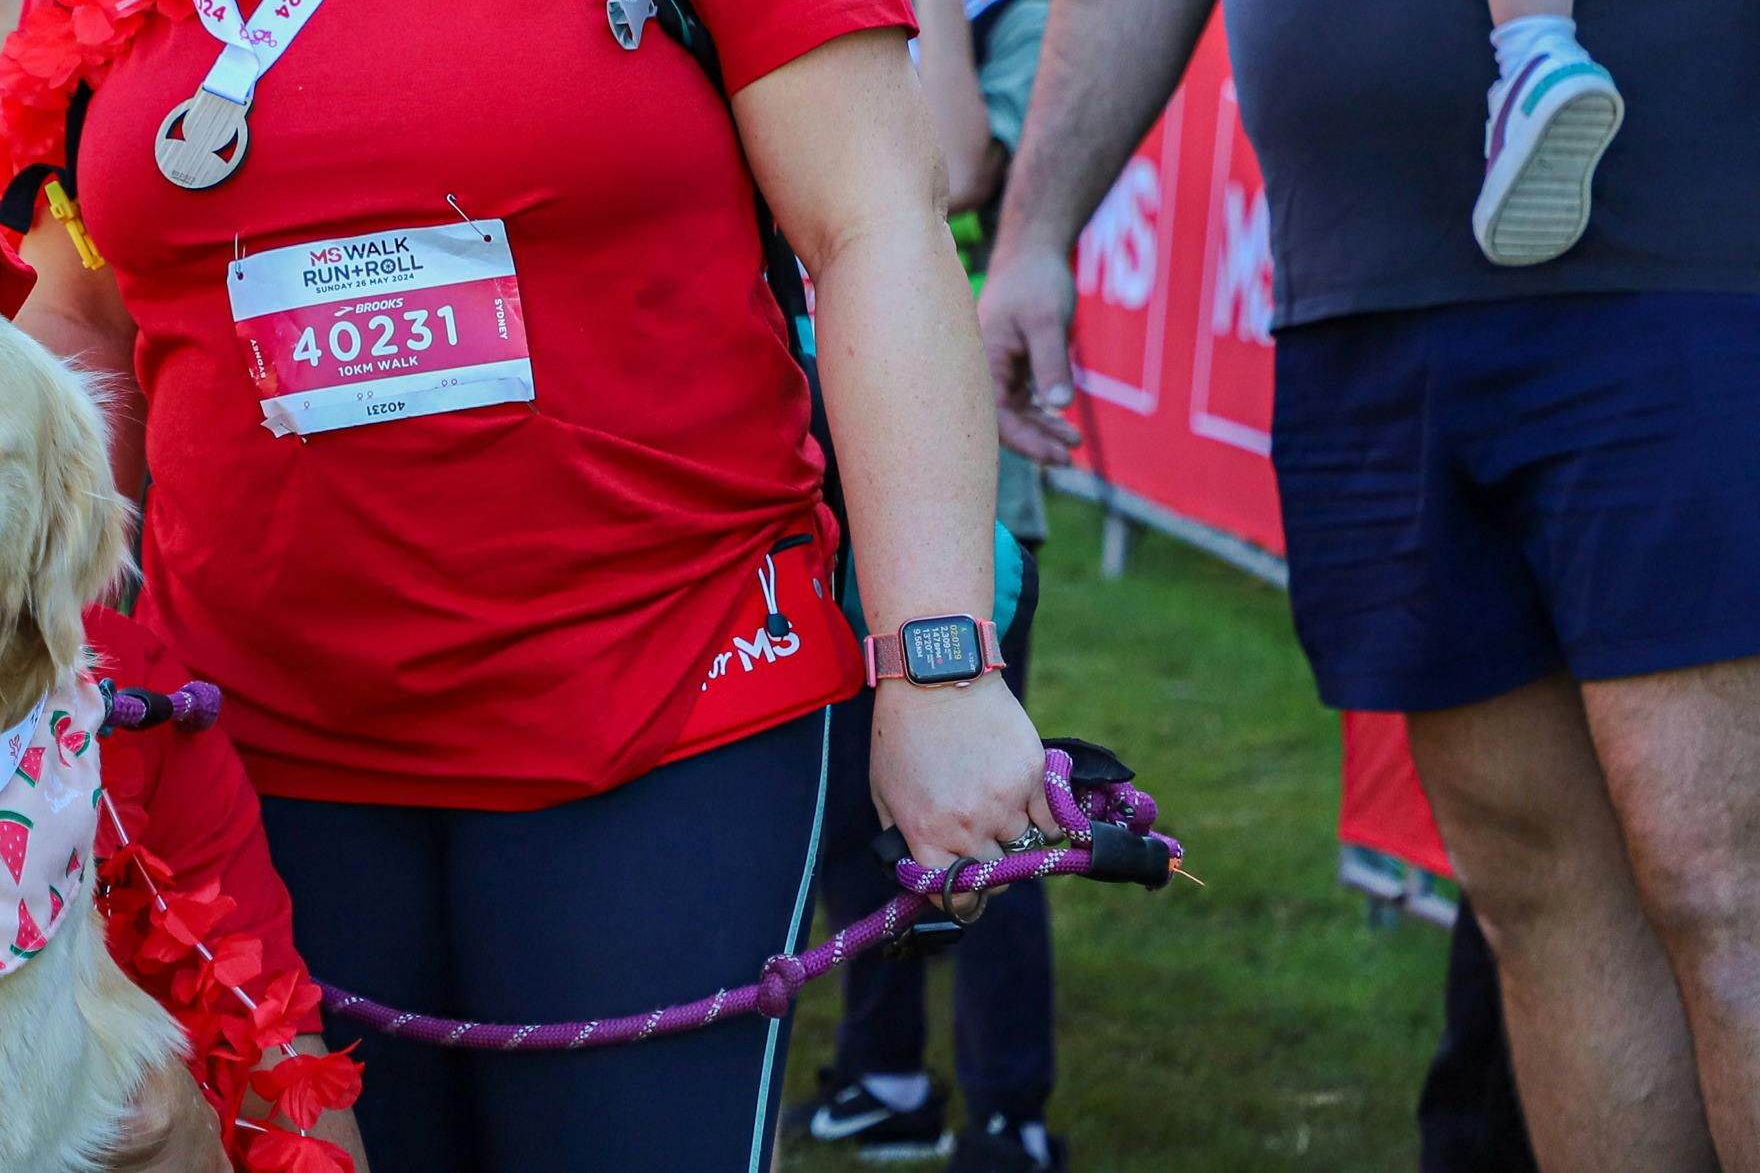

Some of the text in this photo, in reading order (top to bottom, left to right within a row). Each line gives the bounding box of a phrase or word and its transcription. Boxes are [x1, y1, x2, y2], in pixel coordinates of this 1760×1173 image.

[342, 237, 409, 262] WALK
[303, 254, 424, 288] RUN+ROLL
[316, 272, 415, 294] SUNDAY 26 MAY 2024
[355, 297, 404, 314] BROOKS
[493, 298, 510, 340] SYDNEY
[292, 305, 458, 367] 40231
[249, 338, 267, 379] SYDNEY
[338, 355, 419, 377] 10KM WALK
[366, 400, 406, 416] 40231
[732, 621, 800, 672] MS
[950, 624, 961, 661] 02:07:29
